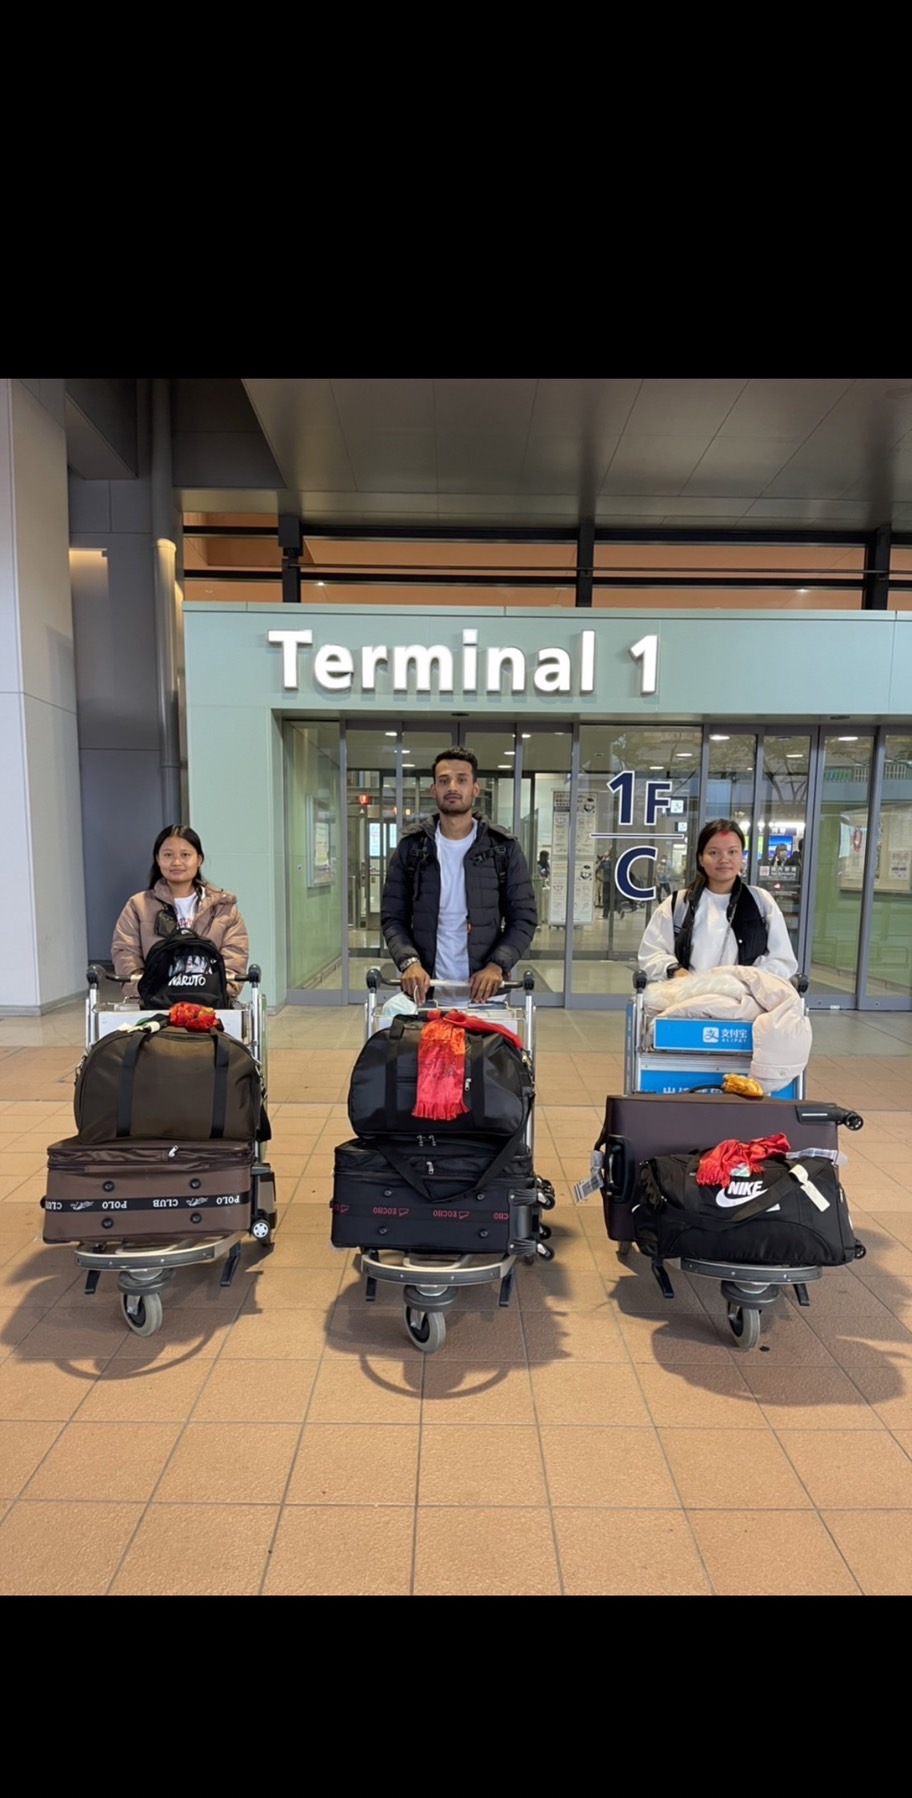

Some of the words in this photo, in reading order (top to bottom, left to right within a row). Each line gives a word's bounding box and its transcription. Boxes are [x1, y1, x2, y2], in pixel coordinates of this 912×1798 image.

[267, 628, 597, 694] Terminal
[627, 634, 659, 694] 1
[606, 770, 673, 826] 1F
[614, 845, 659, 901] C
[168, 973, 207, 987] NARUTO
[720, 1028, 748, 1040] 支付宝
[727, 1180, 764, 1196] NIKE
[45, 1200, 63, 1210] CLU
[101, 1200, 128, 1210] POLO
[152, 1198, 179, 1208] CLUB
[216, 1194, 240, 1206] POLO
[493, 1212, 509, 1220] CHO
